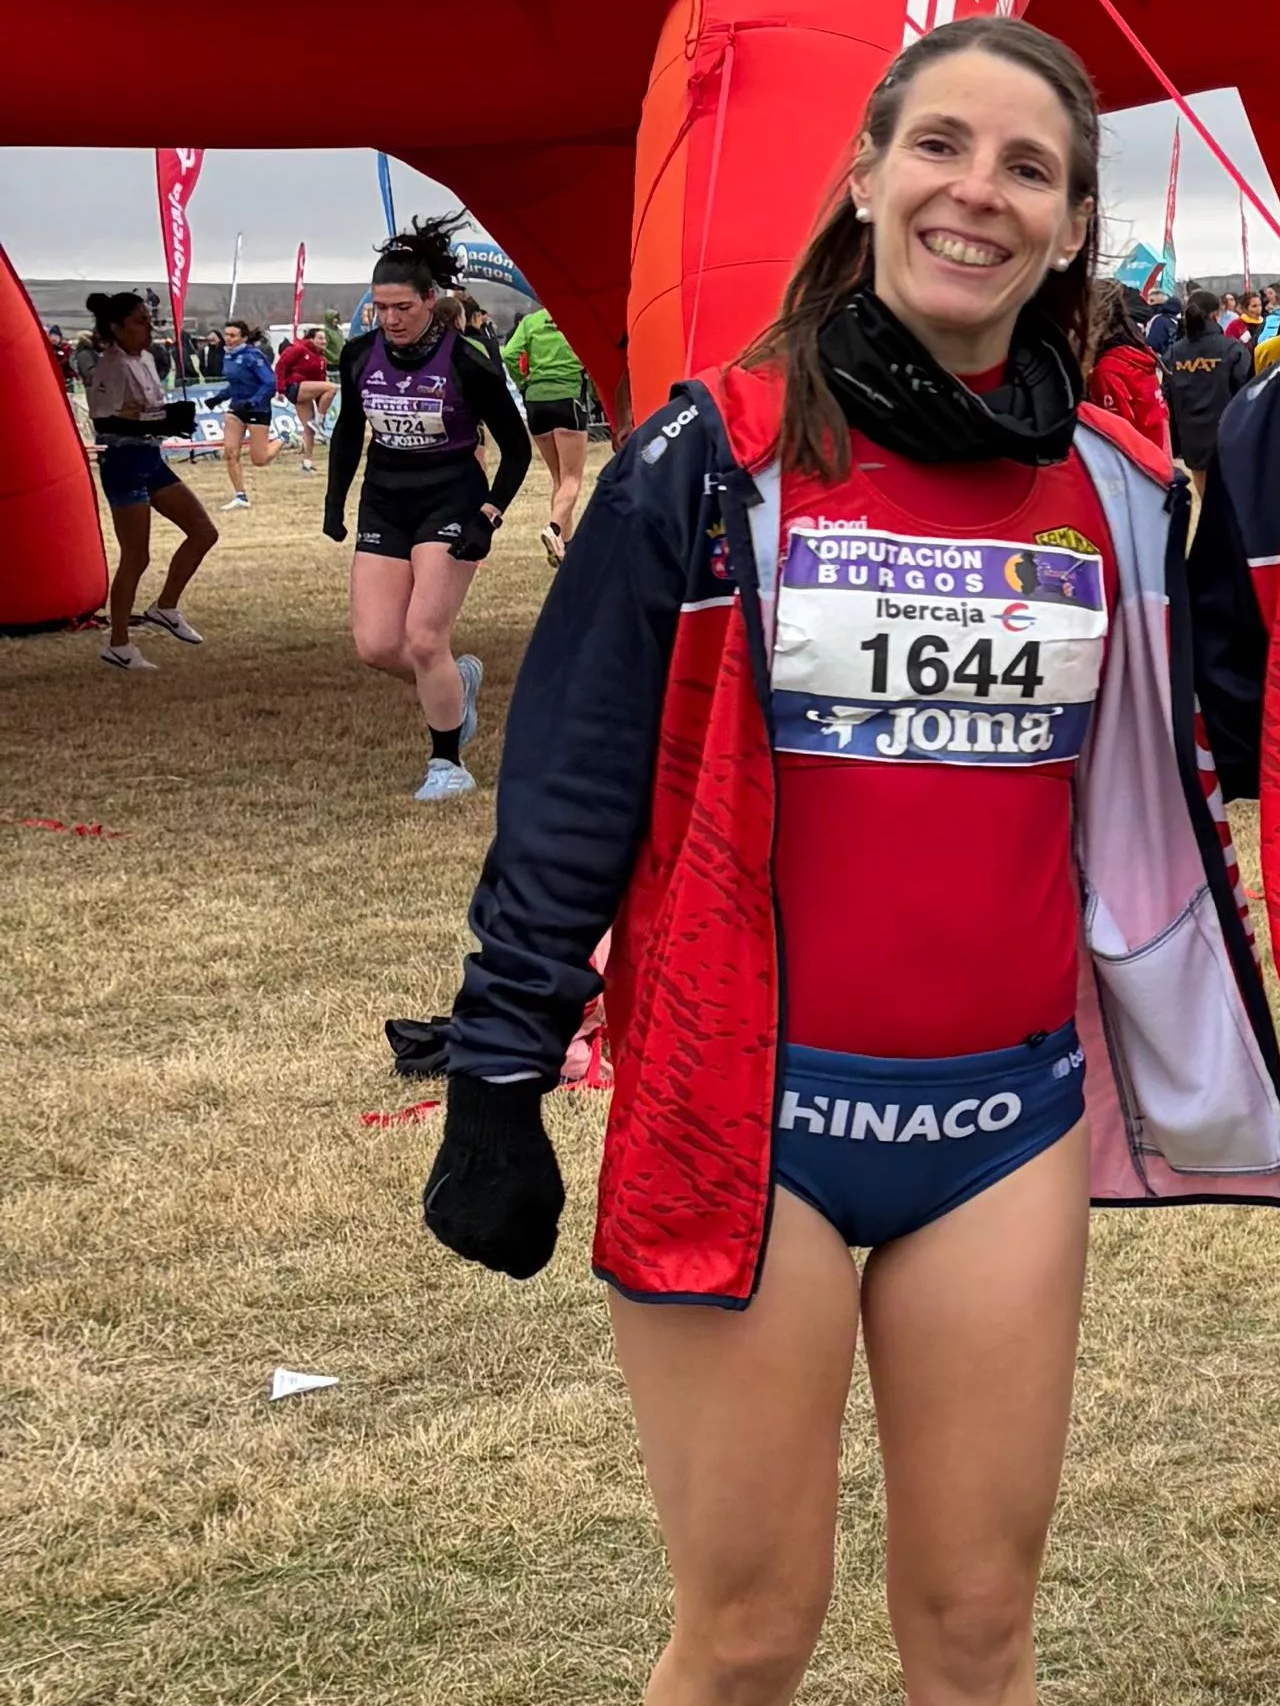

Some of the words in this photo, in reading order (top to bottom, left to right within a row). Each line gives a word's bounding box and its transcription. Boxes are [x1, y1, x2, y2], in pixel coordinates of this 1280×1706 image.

[383, 419, 426, 434] 1724
[820, 539, 983, 570] DIPUTACIÓN
[817, 564, 984, 593] BURGOS
[876, 598, 985, 628] Ibercaja
[860, 633, 1044, 699] 1644
[876, 706, 1056, 755] Joma
[778, 1091, 1022, 1143] HINACO
